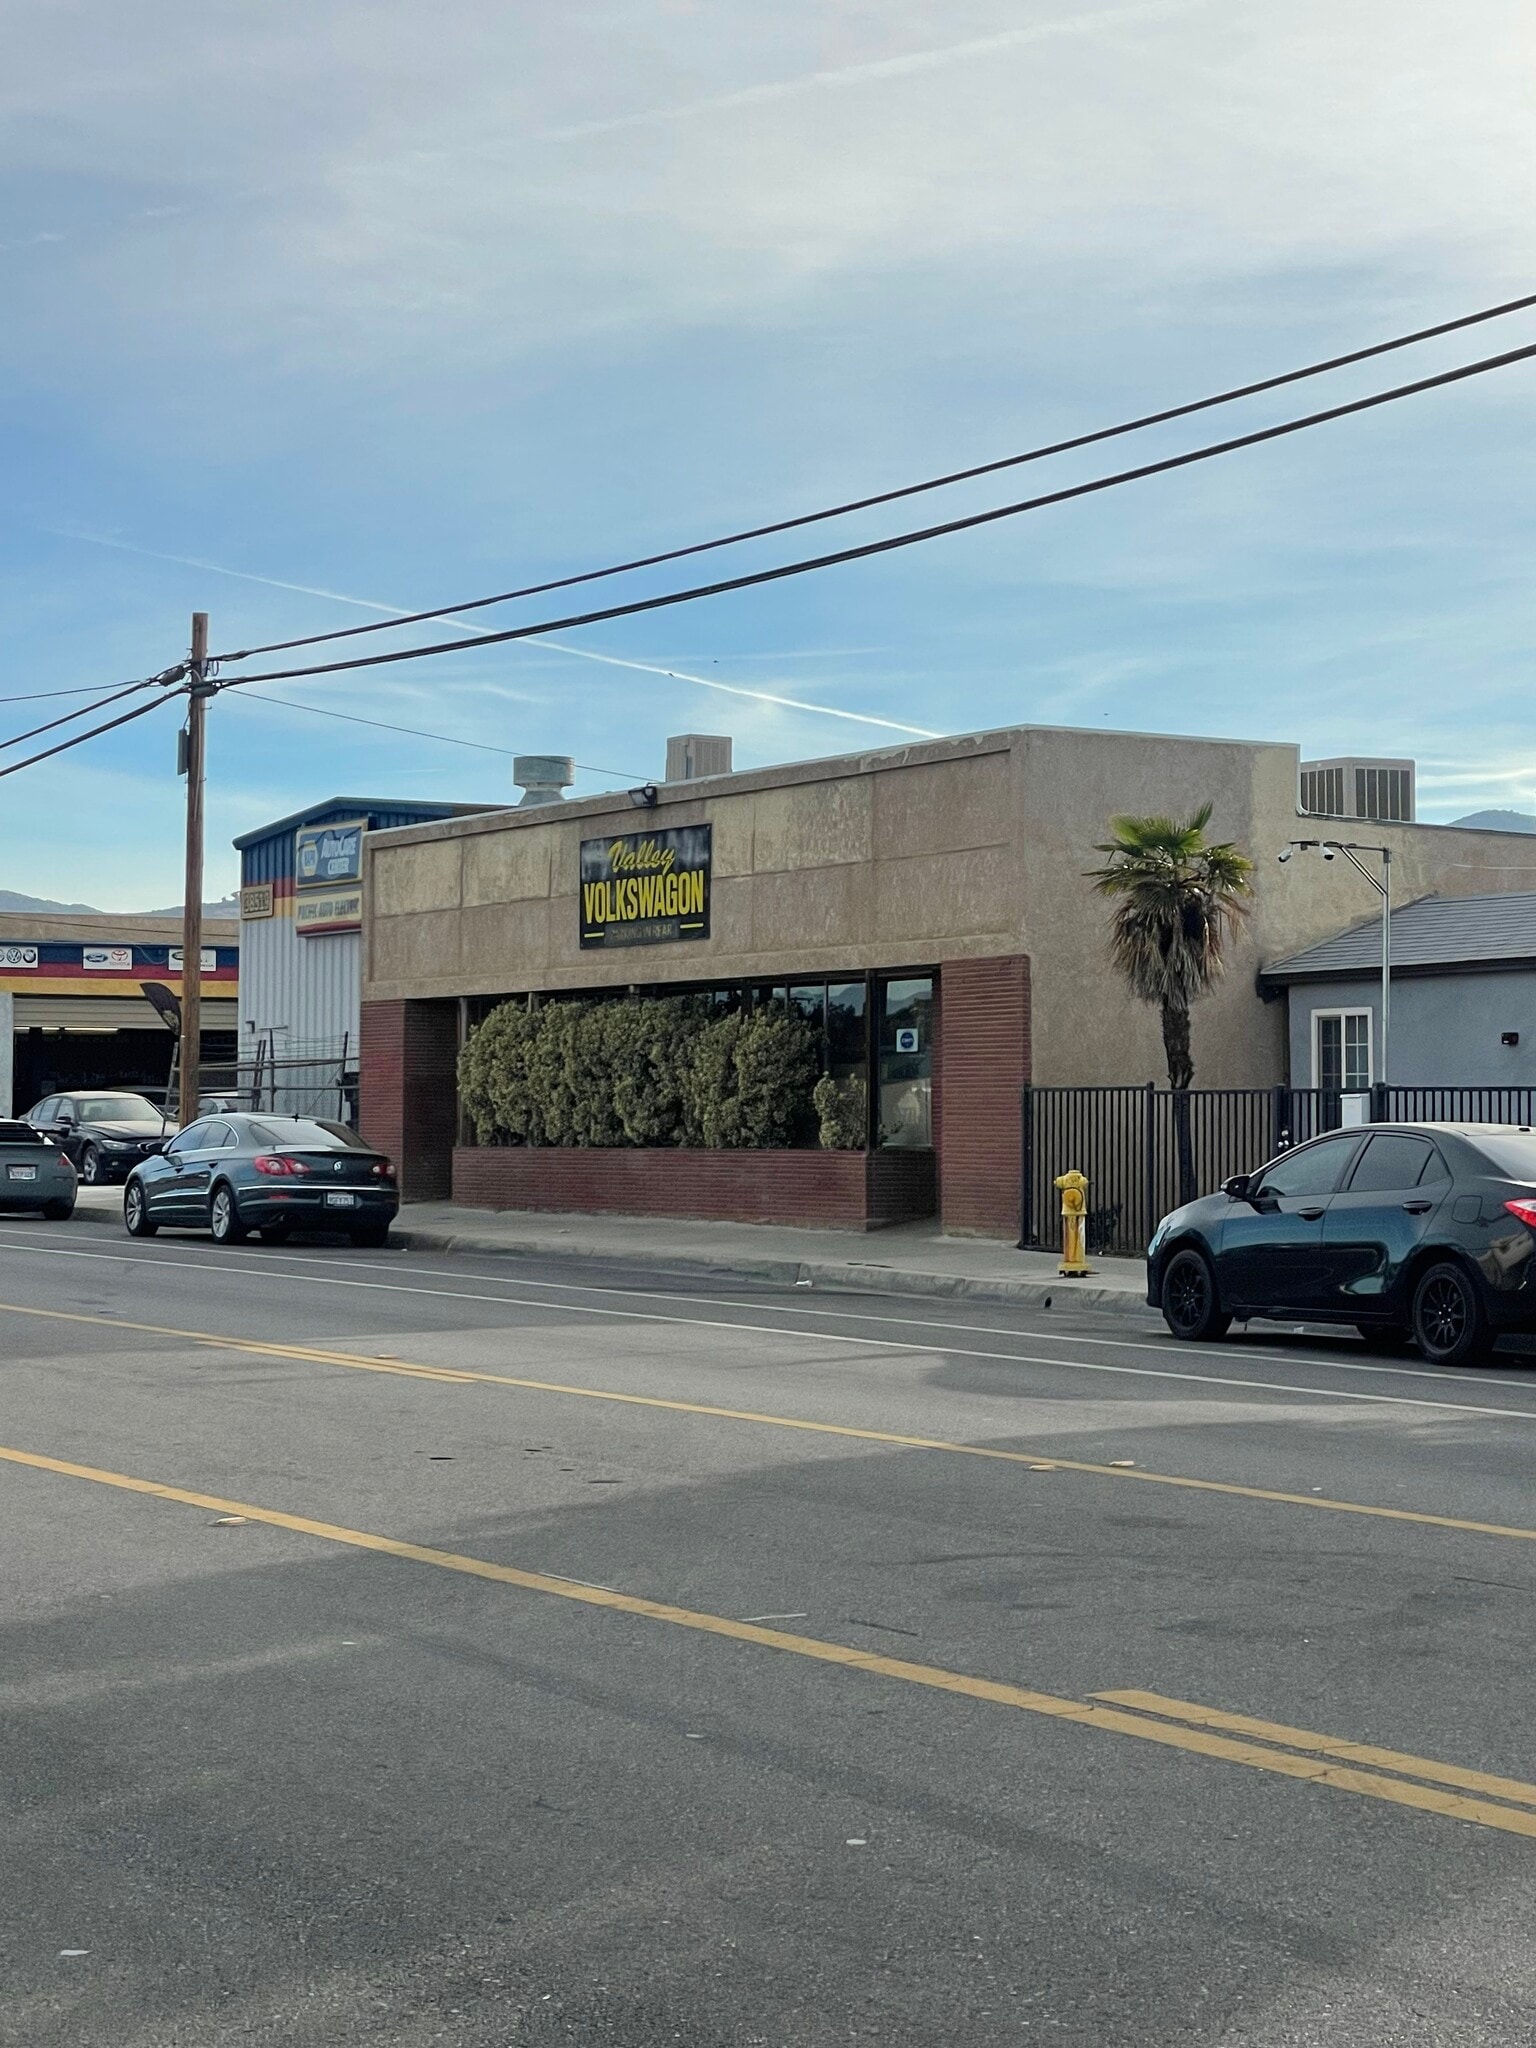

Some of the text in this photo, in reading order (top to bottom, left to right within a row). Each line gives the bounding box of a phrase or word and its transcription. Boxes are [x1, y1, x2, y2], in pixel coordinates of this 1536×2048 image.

[608, 839, 675, 876] Valley
[318, 901, 333, 918] AUTO
[334, 897, 360, 916] ELECTRIC
[584, 870, 704, 924] VOLKSWAGON
[652, 924, 673, 936] REAR
